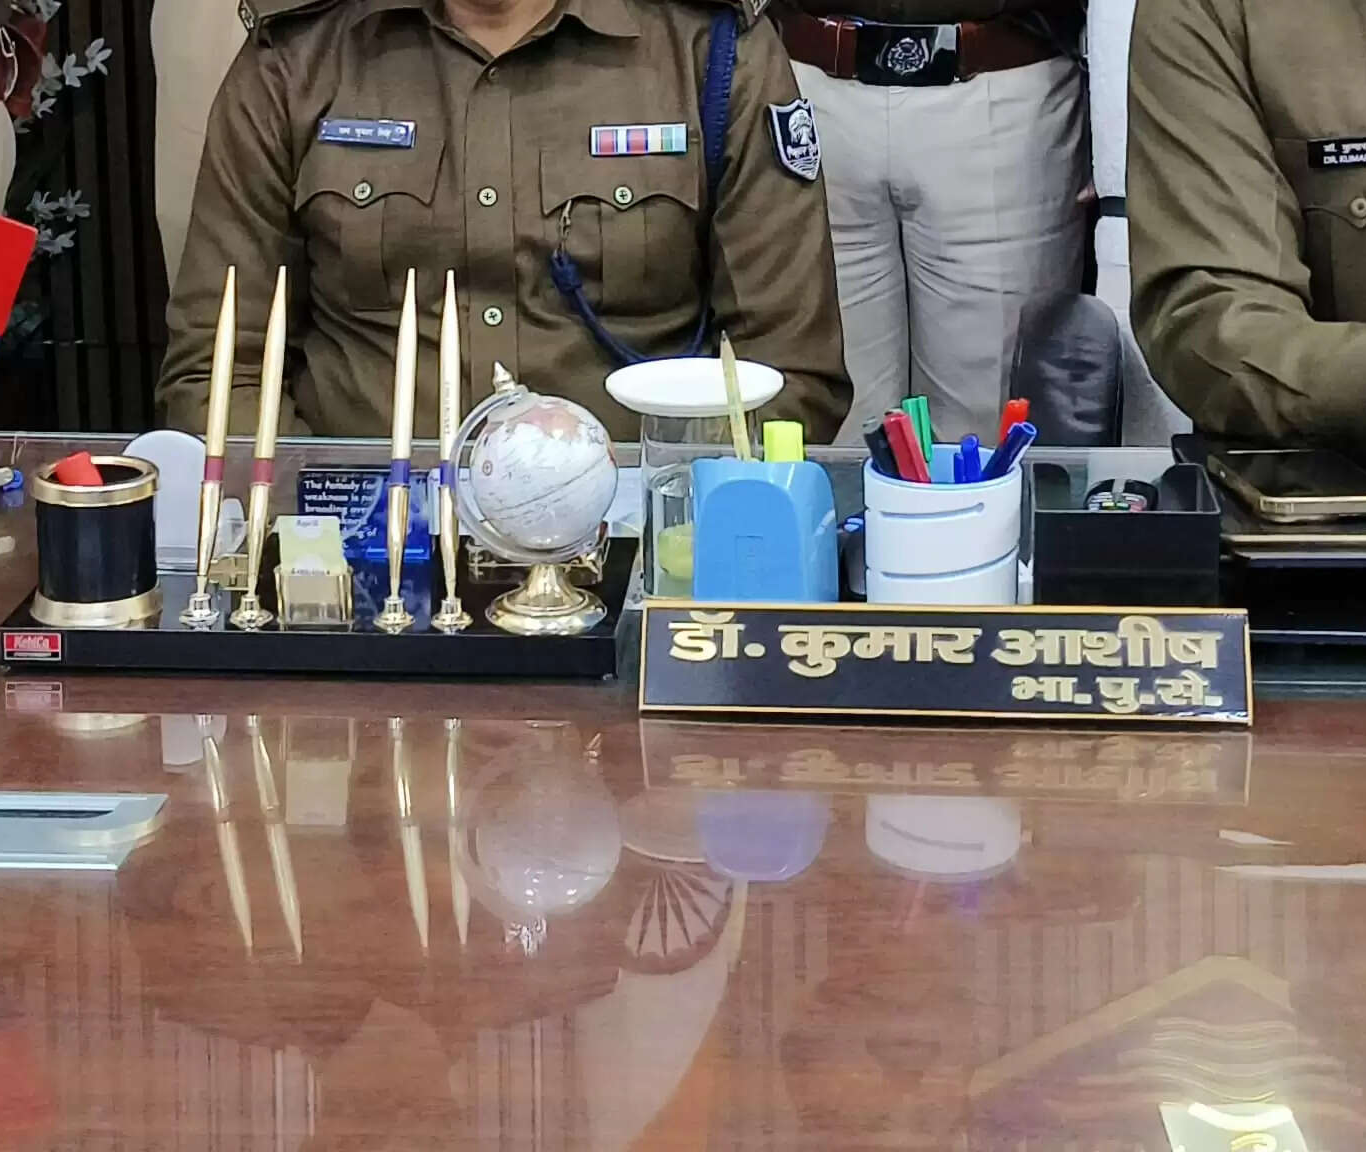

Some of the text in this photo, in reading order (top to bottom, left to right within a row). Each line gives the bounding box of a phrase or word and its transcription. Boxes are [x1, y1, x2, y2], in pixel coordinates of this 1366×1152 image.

[304, 479, 323, 490] The
[669, 610, 1221, 678] डॉ. कुमार आशीष
[1011, 671, 1224, 715] भा.पु.से.
